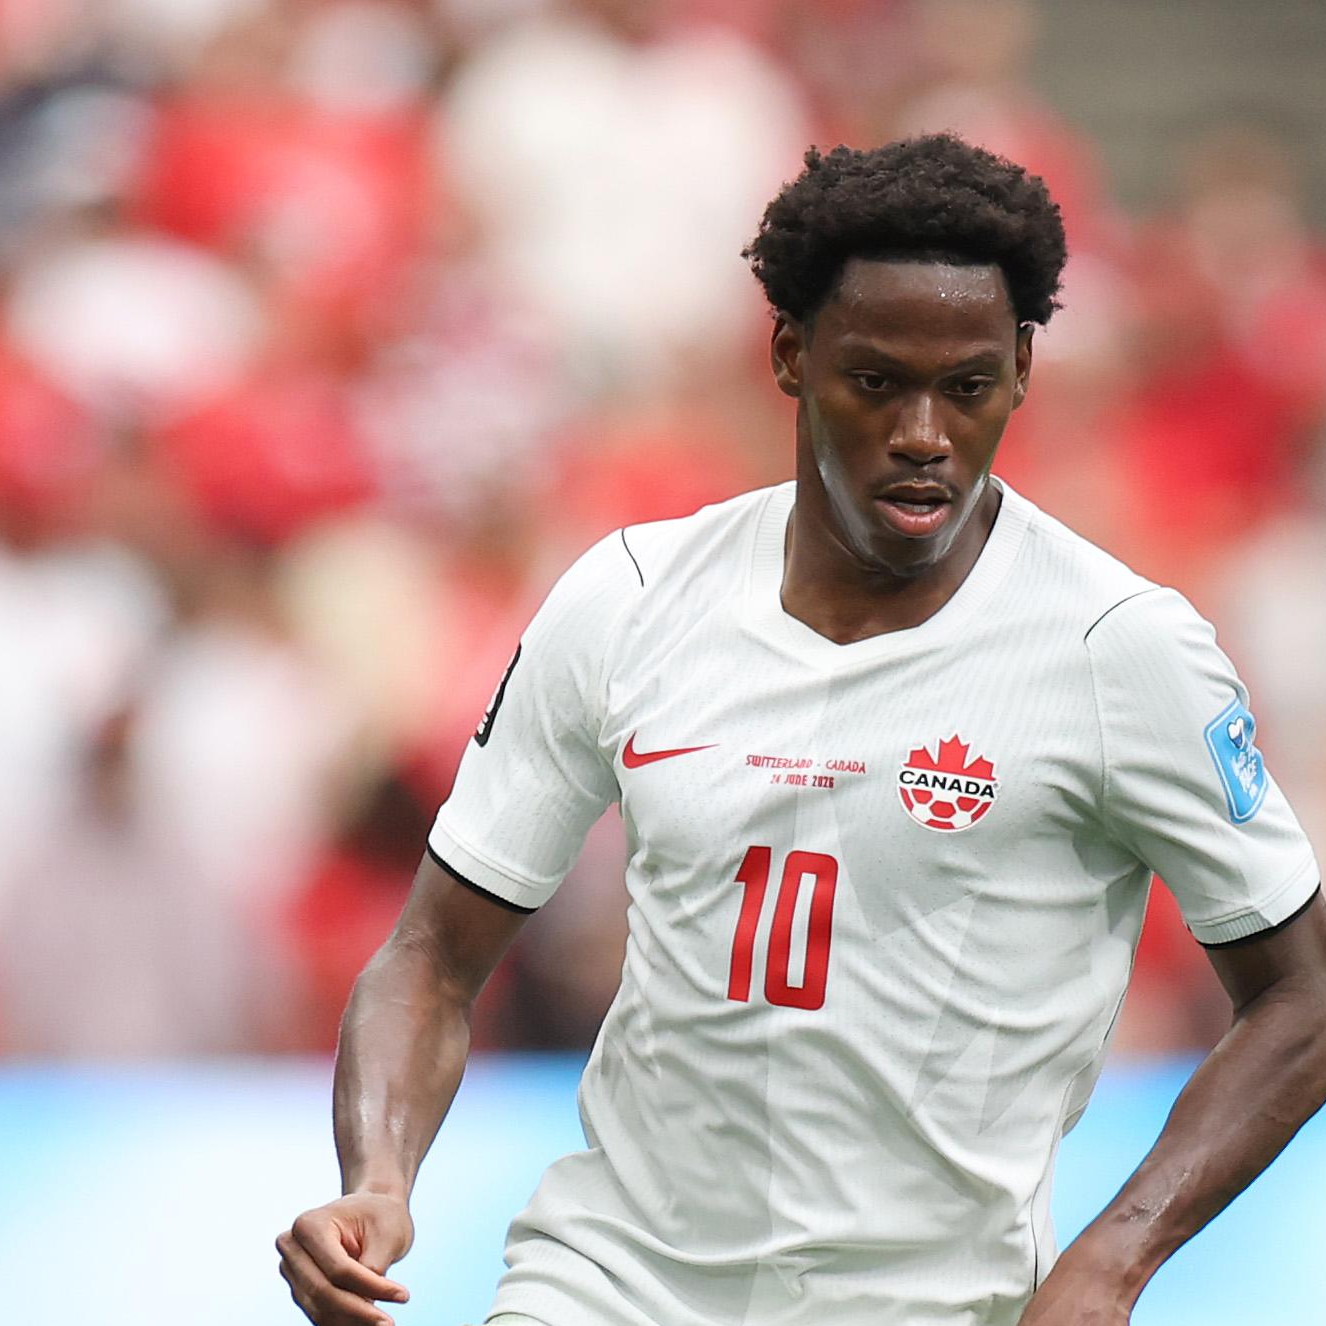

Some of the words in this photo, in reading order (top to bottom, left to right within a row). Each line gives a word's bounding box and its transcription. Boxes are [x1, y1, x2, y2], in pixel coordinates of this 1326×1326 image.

[746, 755, 813, 769] SWITZERLAND
[825, 760, 866, 774] CANADA
[812, 775, 834, 788] 2026
[899, 770, 994, 798] CANADA
[727, 845, 839, 1011] 10
